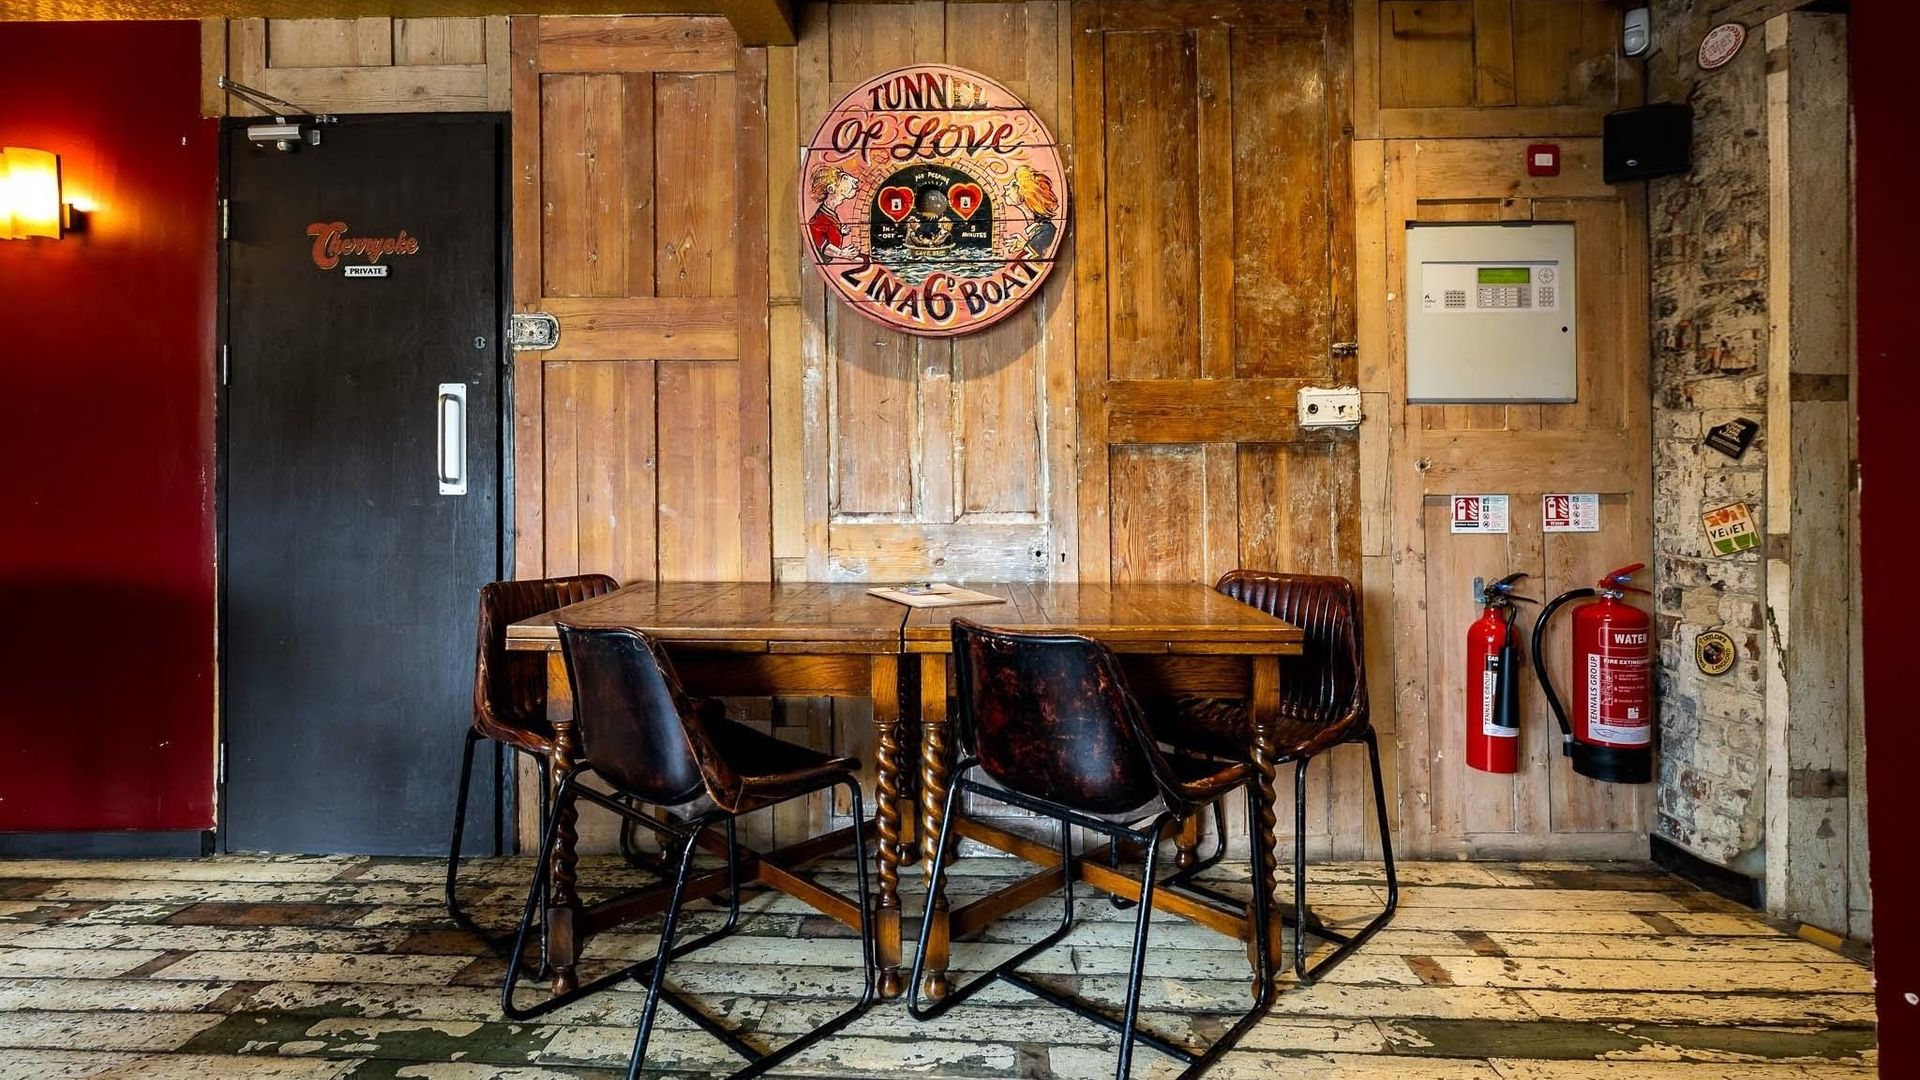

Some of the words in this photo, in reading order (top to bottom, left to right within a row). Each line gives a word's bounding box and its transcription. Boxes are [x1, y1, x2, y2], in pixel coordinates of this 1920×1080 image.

[962, 231, 987, 239] MINUTES
[349, 267, 383, 275] PRIVATE
[841, 254, 871, 287] 2
[866, 267, 899, 307] IN
[897, 288, 920, 318] A
[959, 251, 1038, 316] BOAT
[1614, 633, 1648, 644] WATER
[1590, 656, 1598, 686] GROUP
[1590, 687, 1598, 724] TENNALS
